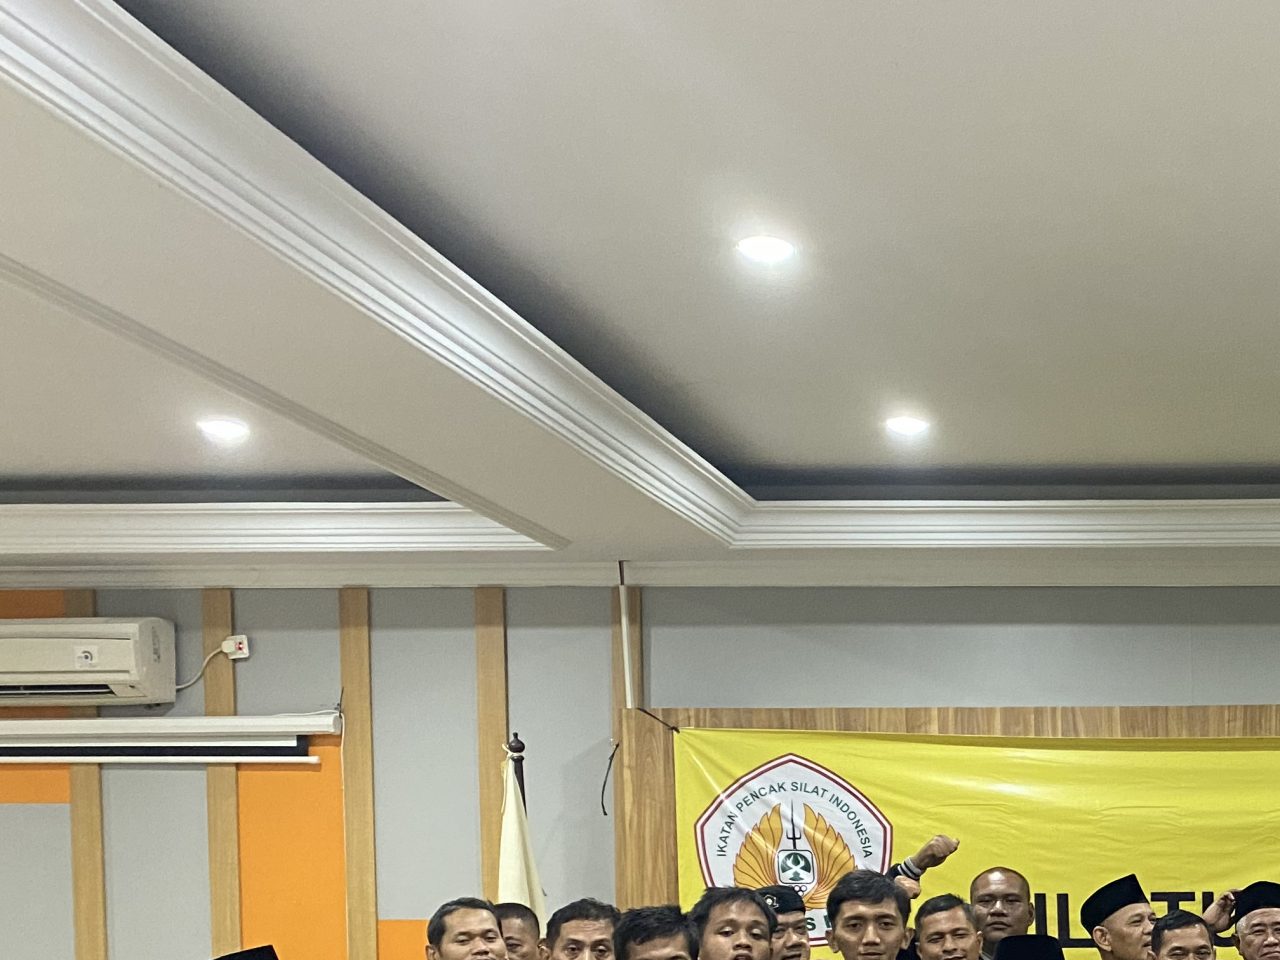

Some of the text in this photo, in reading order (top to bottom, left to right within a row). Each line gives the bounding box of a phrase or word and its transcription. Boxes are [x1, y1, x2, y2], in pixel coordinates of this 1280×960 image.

[717, 781, 873, 859] IKATAN PENCAK SILAT INDONESIA
